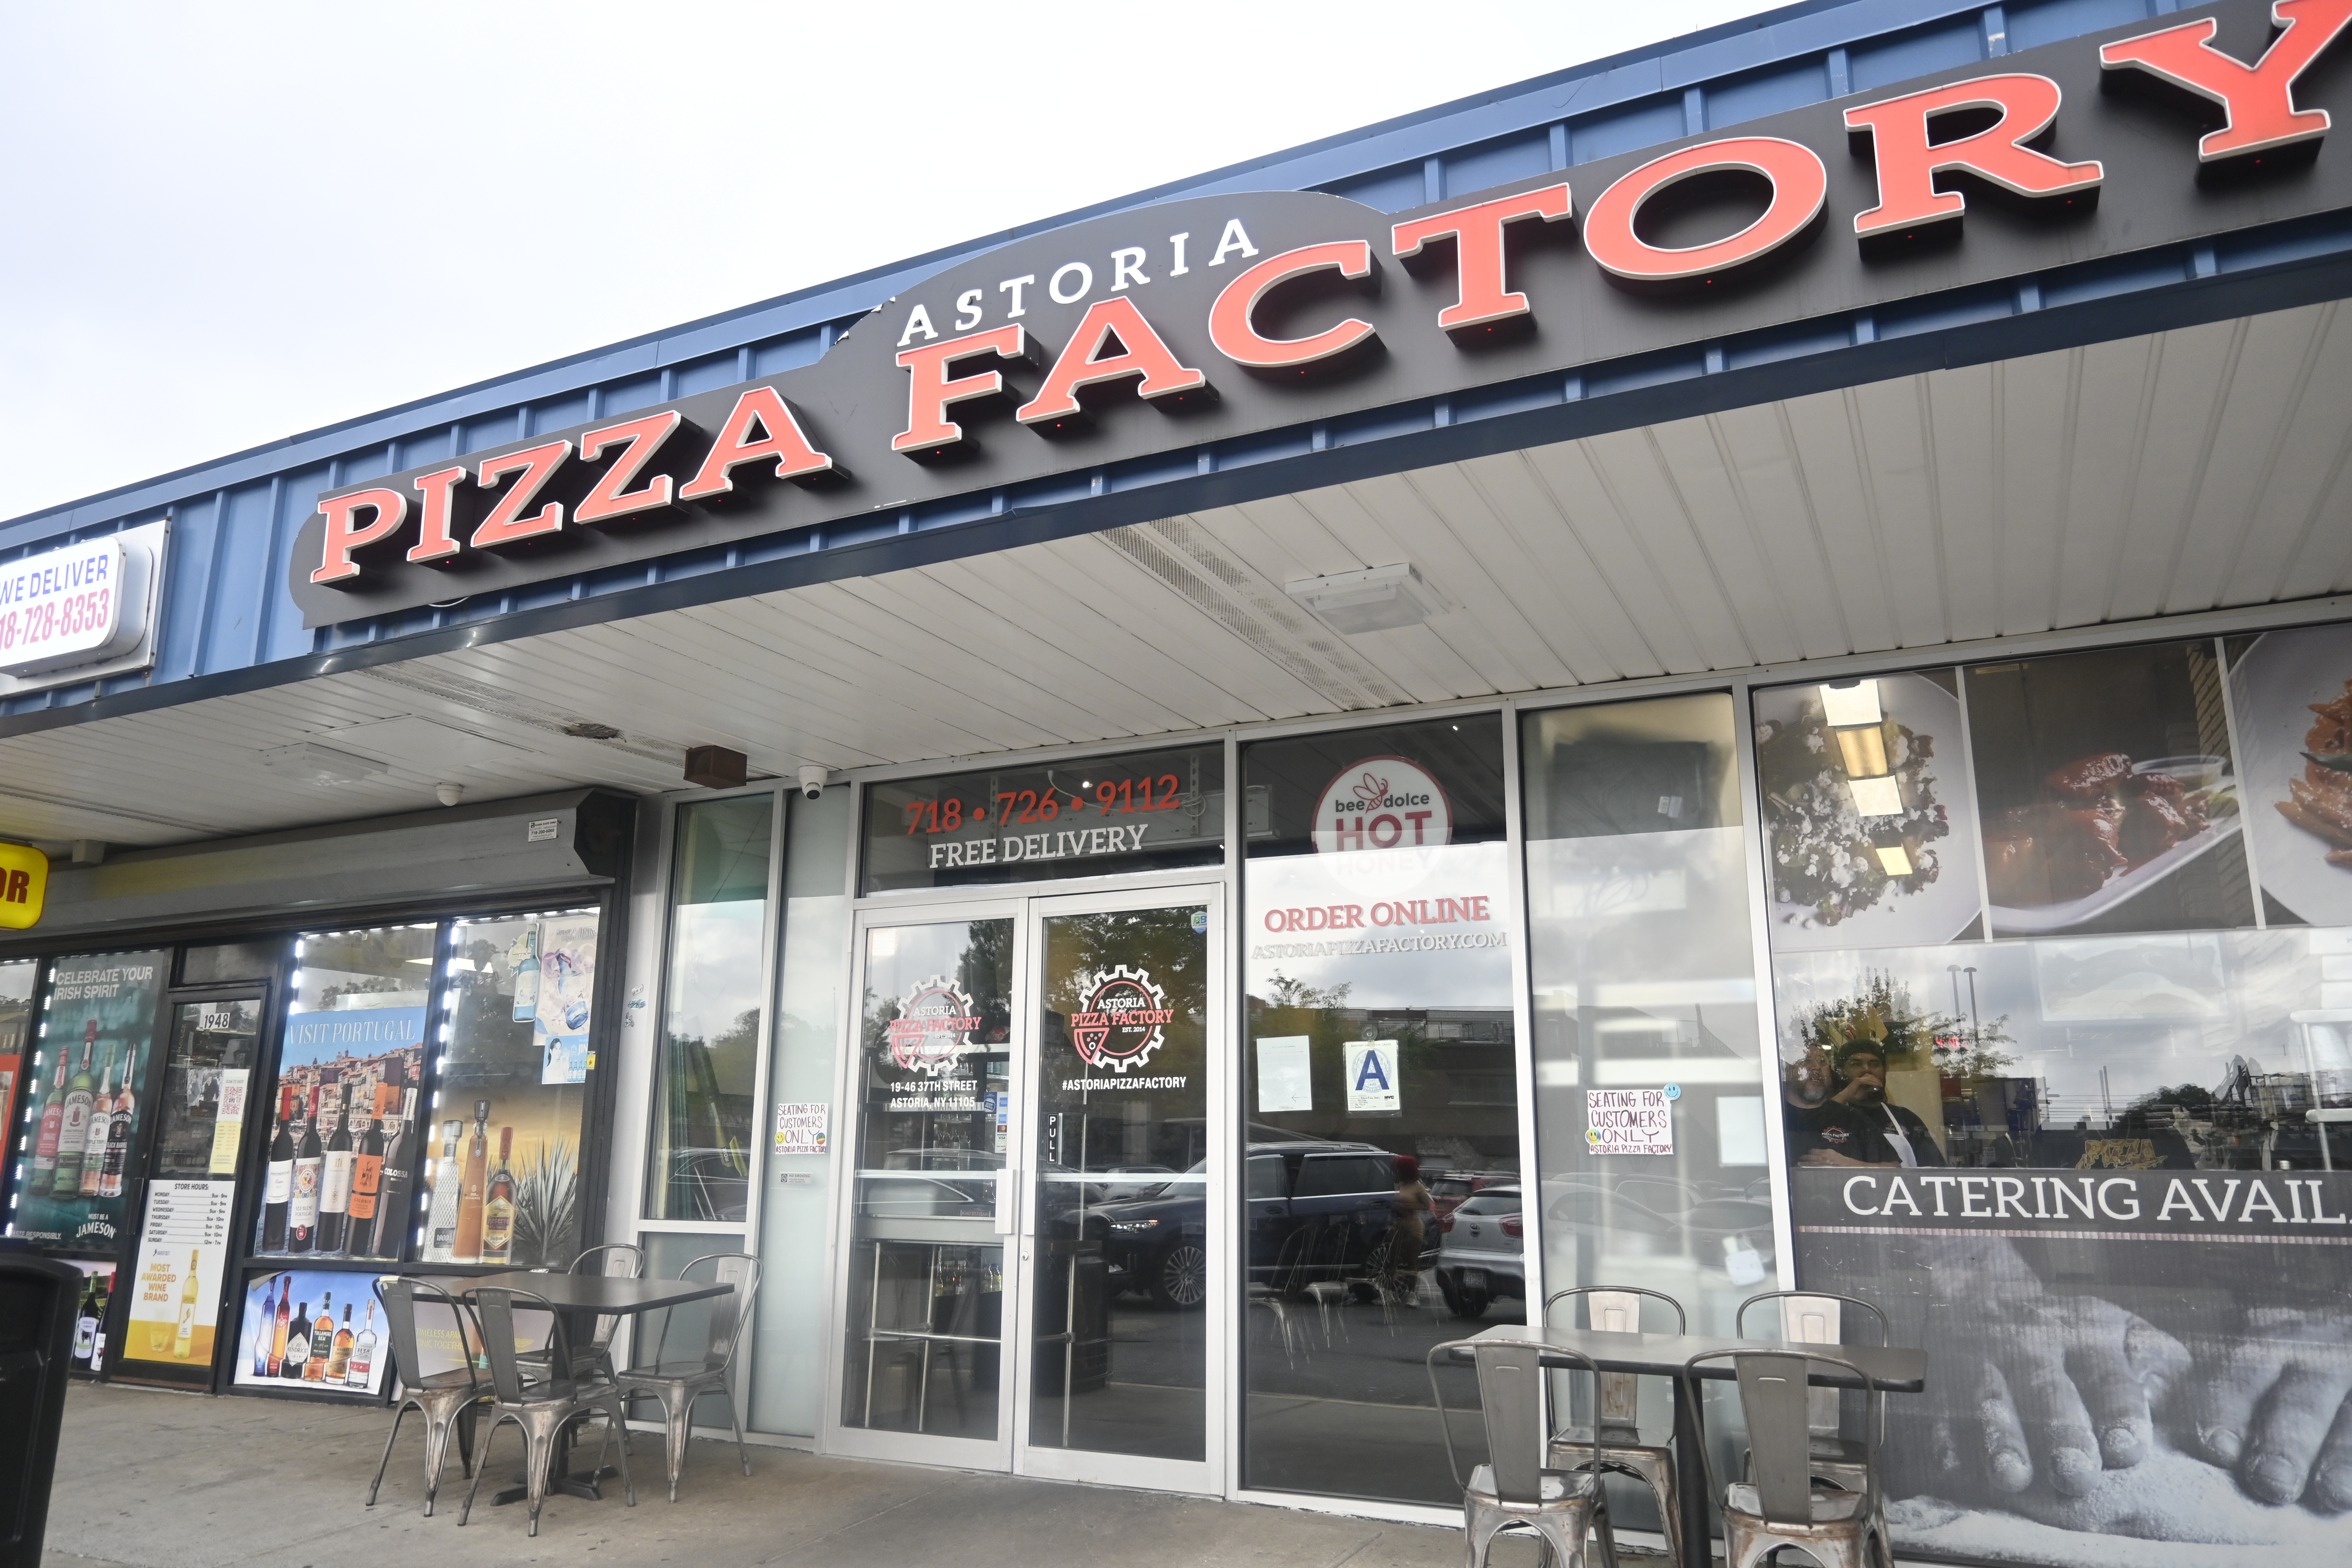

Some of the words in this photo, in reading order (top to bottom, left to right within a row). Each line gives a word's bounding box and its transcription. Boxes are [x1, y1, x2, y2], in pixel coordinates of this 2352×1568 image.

[897, 218, 1258, 346] ASTORIA
[310, 385, 832, 585] PIZZA
[891, 0, 2352, 451] FACTORY
[0, 575, 25, 606] WE
[30, 554, 108, 599] DELIVER
[0, 588, 109, 650] 18-728-8353
[906, 798, 962, 834] 718
[997, 787, 1059, 826] 726
[1096, 774, 1180, 815] 9112
[1335, 799, 1365, 813] bee
[1383, 792, 1430, 808] dolce
[1336, 810, 1432, 852] HOT
[929, 838, 997, 868] FREE
[1002, 823, 1148, 864] DELIVERY
[1264, 904, 1364, 933] ORDER
[1369, 895, 1490, 927] ONLINE
[1252, 931, 1508, 960] ASTORIAPIZZAFACTORY.COM
[56, 969, 120, 985] CELEBRATE
[122, 966, 153, 981] YOUR
[53, 986, 82, 1001] IRISH
[84, 984, 120, 999] SPIRIT
[913, 1005, 956, 1016] ASTORIA
[1097, 997, 1146, 1009] ASTORIA
[204, 1013, 229, 1029] 1948
[889, 1019, 923, 1033] PIZZA
[926, 1017, 982, 1032] FACTORY
[1071, 1012, 1109, 1027] PIZZA
[1112, 1009, 1174, 1025] FACTORY
[289, 1023, 329, 1044] VISIT
[332, 1019, 416, 1043] PORTUGAL
[1355, 1050, 1390, 1091] A
[890, 1082, 916, 1092] 19-46
[917, 1081, 941, 1092] 37TH
[942, 1080, 977, 1092] STREET
[1062, 1076, 1187, 1091] #ASTORIAPIZZAFACTORY
[65, 1094, 93, 1109] JAMESON
[890, 1097, 932, 1110] ASTORIA,
[934, 1097, 947, 1108] NY
[948, 1097, 975, 1107] 11105
[1589, 1091, 1636, 1108] SEATING
[1642, 1091, 1664, 1107] FOR
[43, 1107, 62, 1119] JAMESO
[778, 1103, 808, 1116] SEATING
[811, 1104, 826, 1115] FOR
[779, 1116, 823, 1130] CUSTOMERS
[1591, 1110, 1667, 1128] CUSTOMERS
[785, 1129, 820, 1145] ONLY
[1602, 1128, 1660, 1144] ONLY
[1590, 1144, 1619, 1154] ASTORIA
[1621, 1144, 1641, 1153] PIZZA
[1643, 1143, 1672, 1154] FACTORY
[2085, 1139, 2156, 1169] PIZZA
[1843, 1175, 2140, 1220] CATERING
[2156, 1178, 2352, 1224] AVAIL
[26, 1231, 62, 1240] RESPONSIBLY.
[76, 1221, 116, 1239] JAMESON
[150, 1263, 171, 1272] MOST
[141, 1273, 177, 1282] AWARDED
[149, 1283, 167, 1292] WINE
[143, 1292, 169, 1302] BRAND
